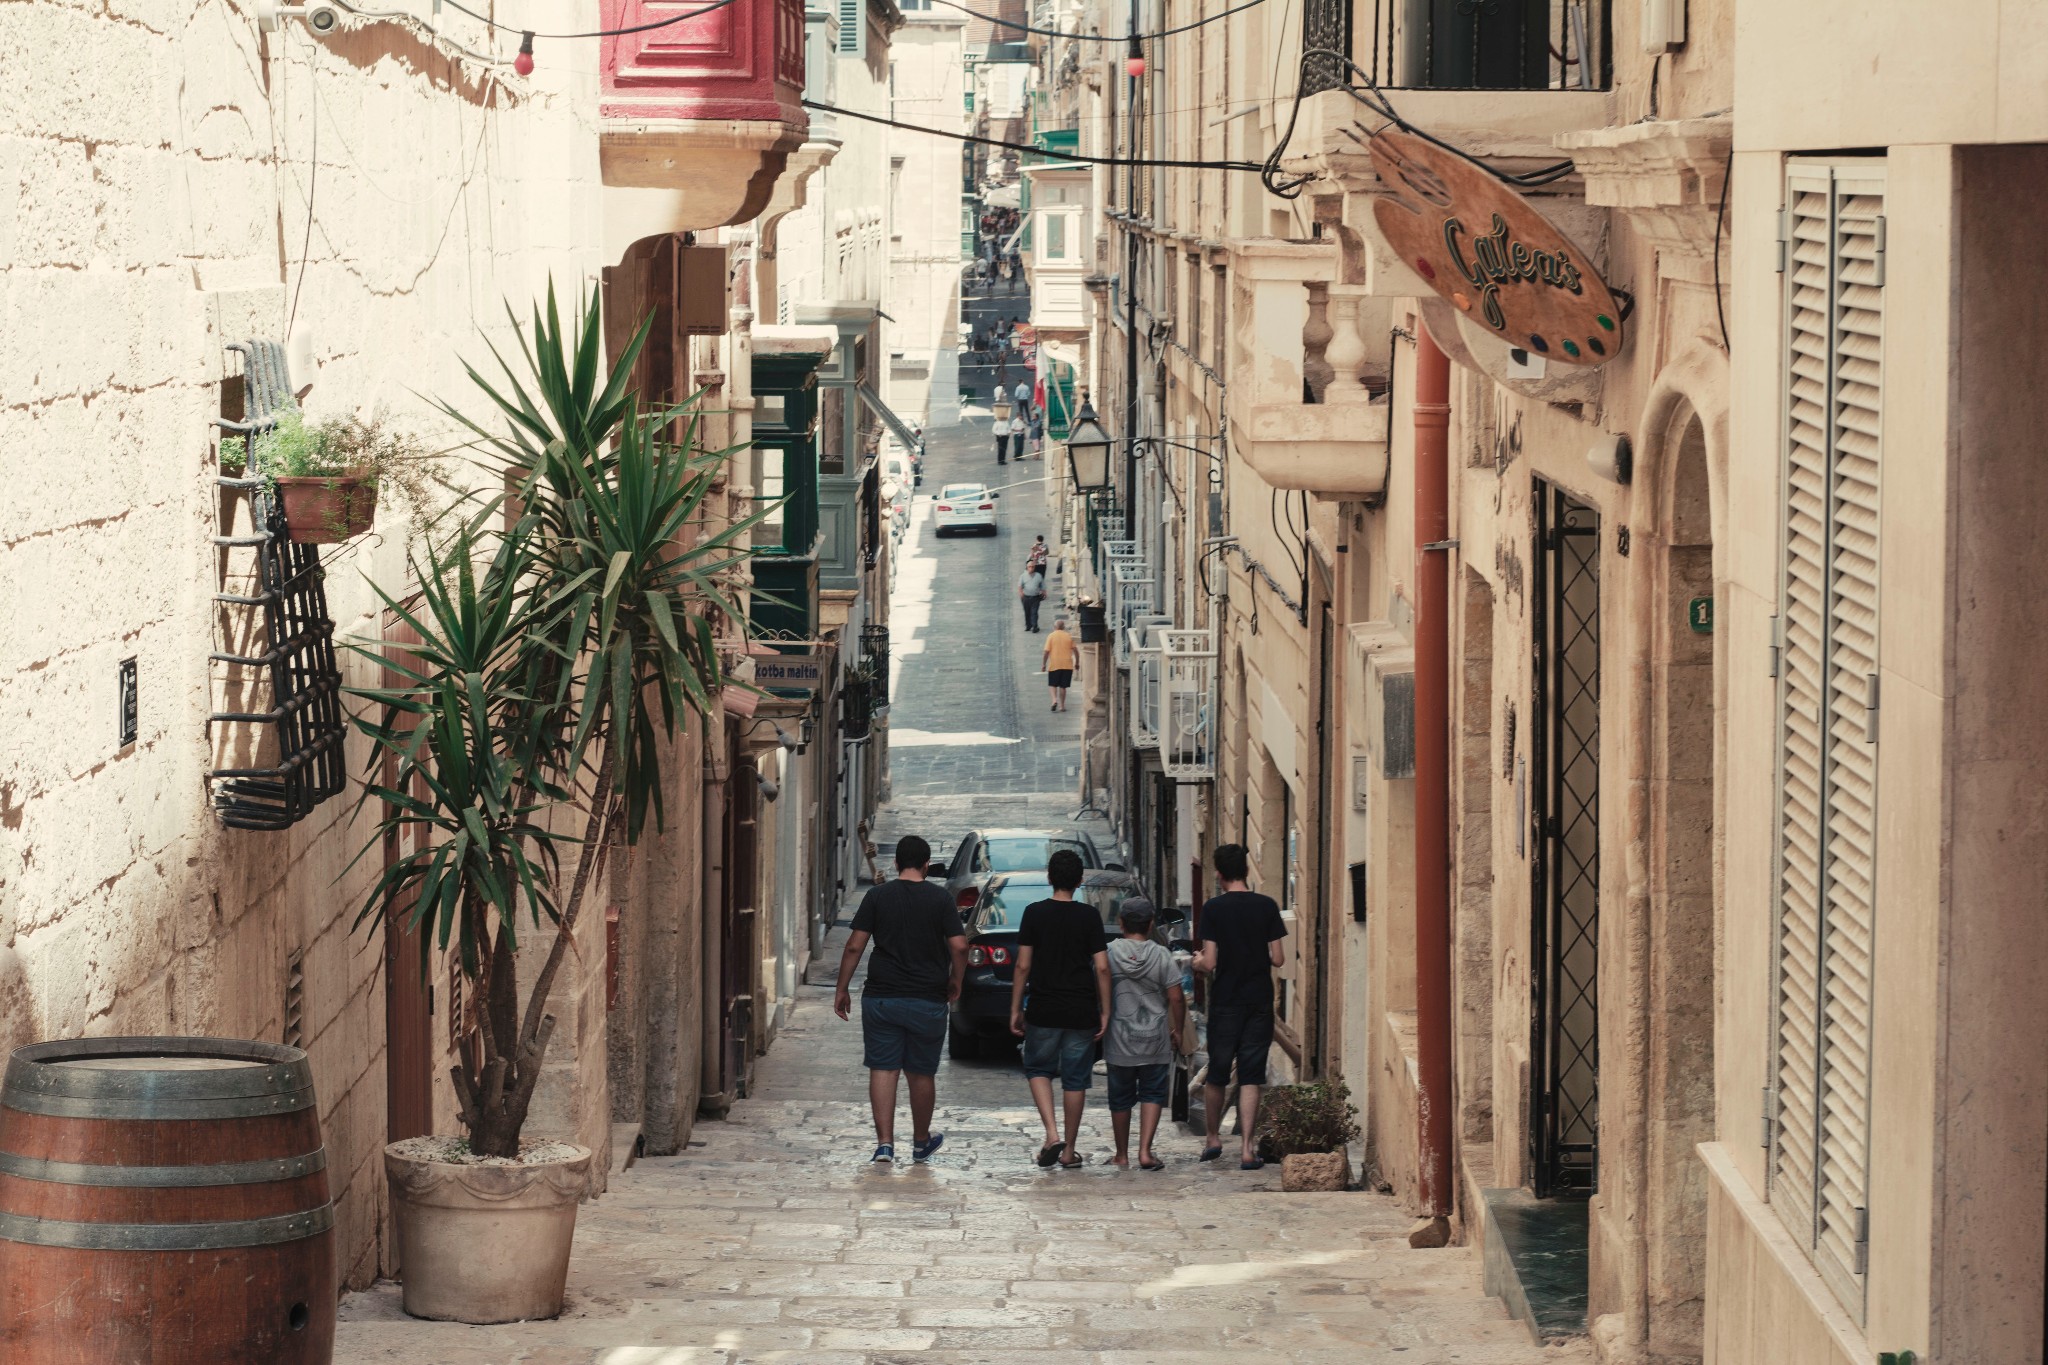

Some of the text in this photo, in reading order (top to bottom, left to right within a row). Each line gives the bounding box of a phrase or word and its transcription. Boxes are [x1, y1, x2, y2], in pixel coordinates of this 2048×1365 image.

[1443, 211, 1581, 329] Galea's
[1696, 602, 1708, 624] 1
[755, 663, 818, 679] kotba maltin
